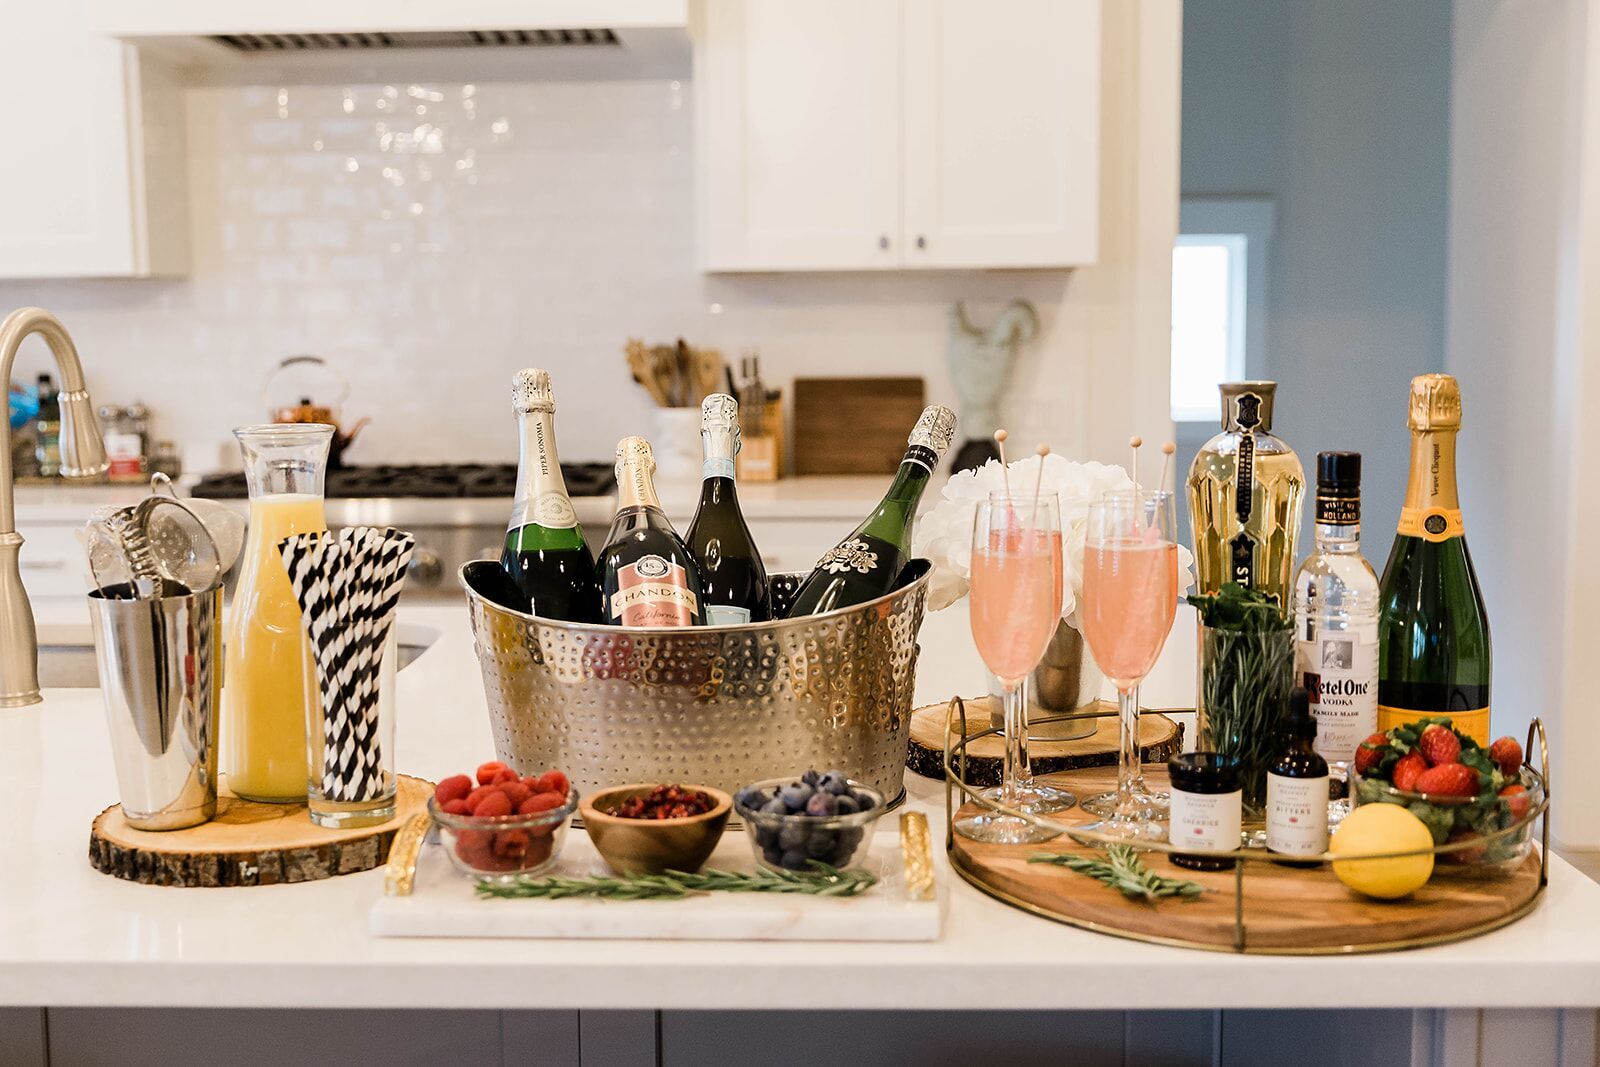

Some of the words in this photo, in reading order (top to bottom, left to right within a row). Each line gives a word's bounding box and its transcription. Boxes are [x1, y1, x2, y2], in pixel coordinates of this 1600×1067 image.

[536, 422, 545, 453] SONOMA
[540, 453, 549, 475] PIPER
[1431, 443, 1440, 474] Clicquot
[635, 468, 646, 502] CHANDON
[1431, 475, 1439, 497] Veuve
[1325, 501, 1345, 509] VISIT
[1323, 511, 1356, 520] HOLLAND
[615, 588, 695, 608] CHANDON
[633, 608, 680, 622] California
[1344, 679, 1368, 696] One
[1322, 698, 1353, 706] VODKA
[1312, 709, 1338, 717] FAMILY
[1276, 806, 1311, 815] BITTERS
